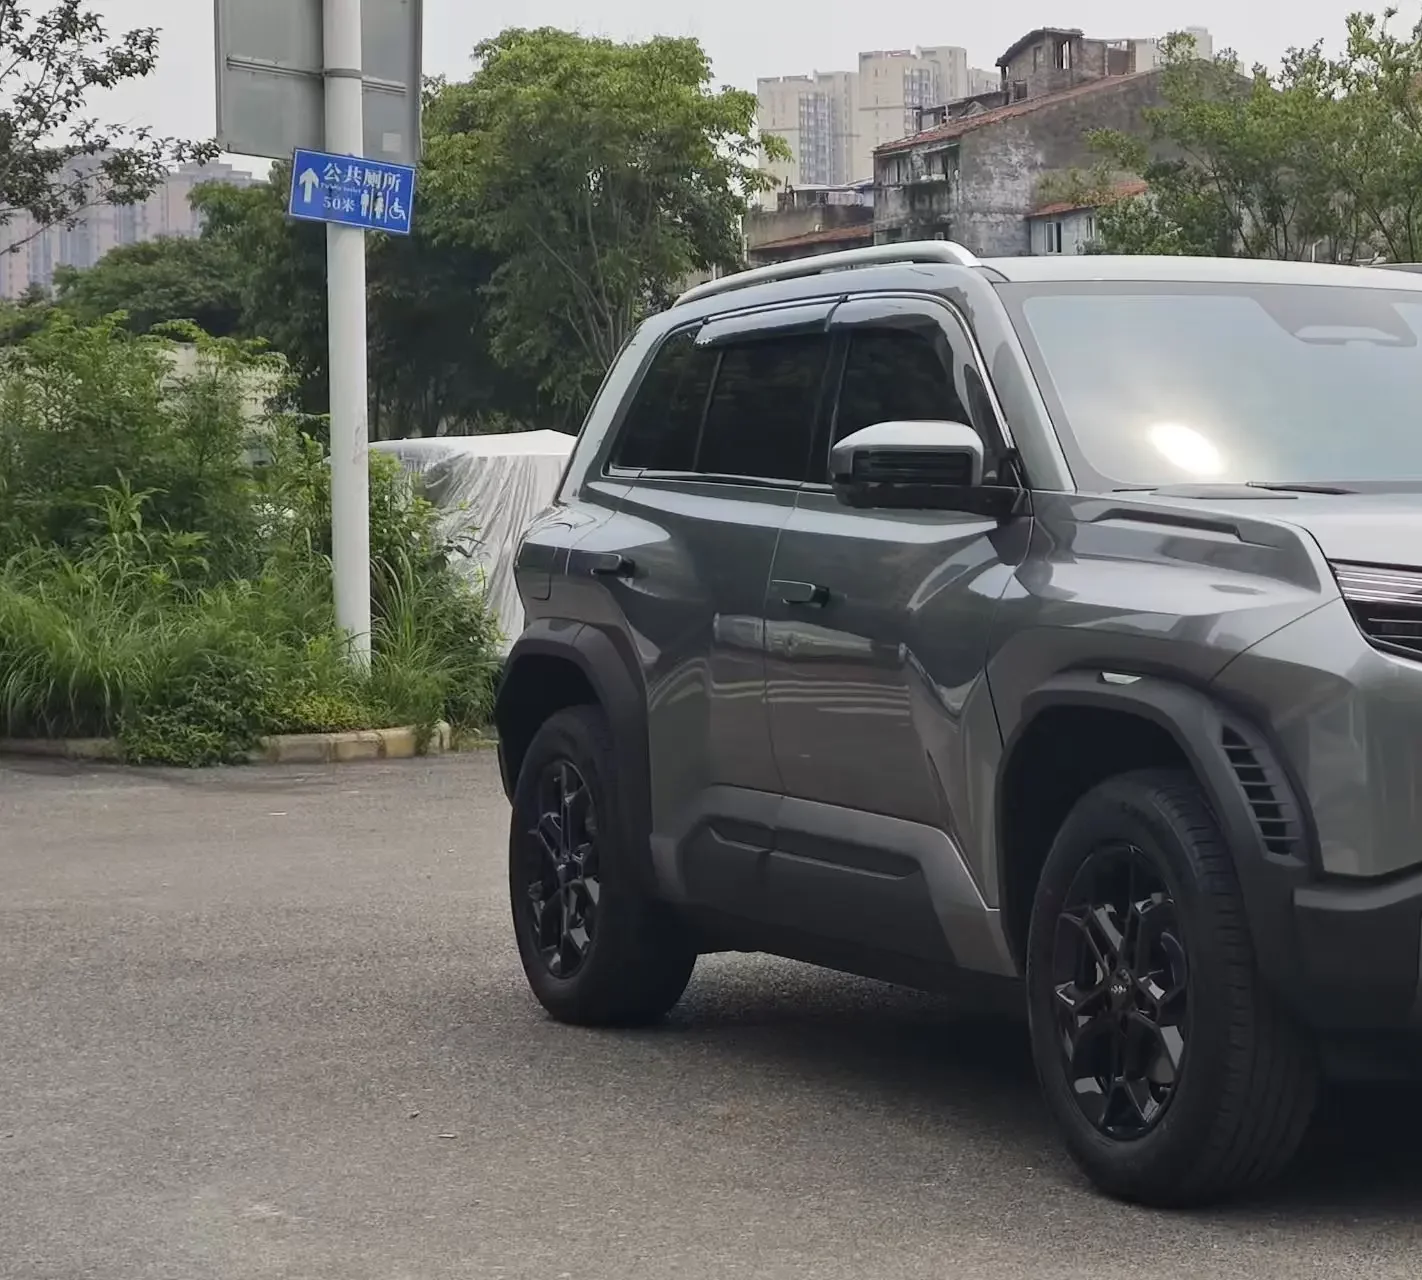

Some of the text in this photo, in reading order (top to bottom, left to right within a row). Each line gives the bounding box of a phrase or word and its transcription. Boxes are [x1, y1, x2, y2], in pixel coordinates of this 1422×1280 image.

[322, 163, 401, 193] 公共厕所
[323, 196, 355, 212] 50米
